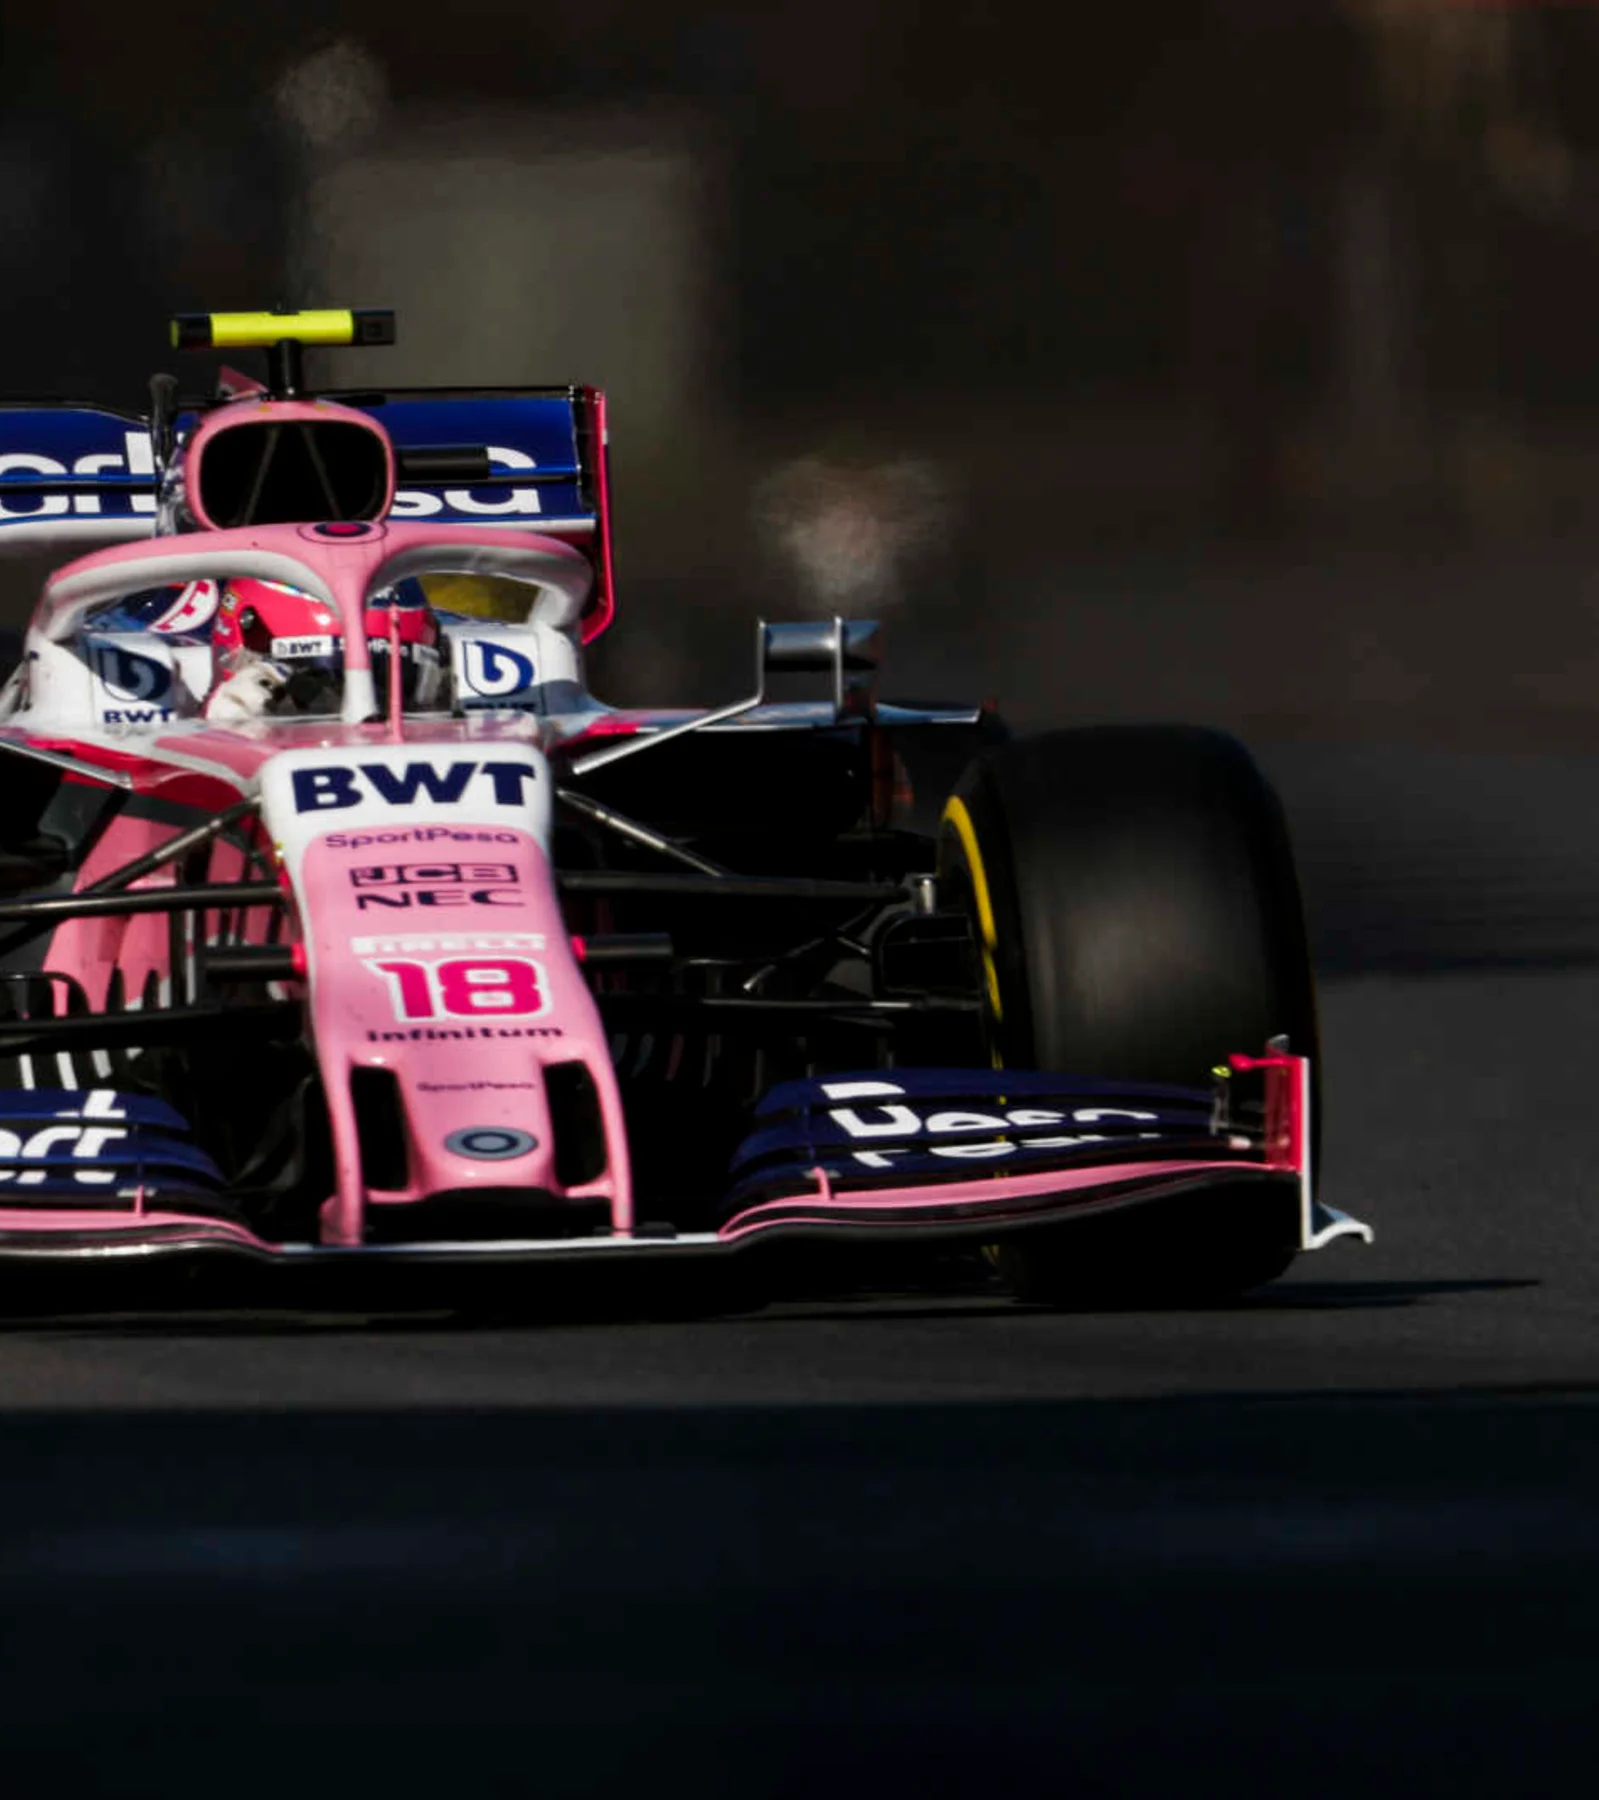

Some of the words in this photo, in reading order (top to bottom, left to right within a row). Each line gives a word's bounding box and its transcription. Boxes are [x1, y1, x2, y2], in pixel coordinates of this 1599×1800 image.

[104, 708, 174, 723] BWT
[292, 762, 535, 813] BWT
[326, 827, 519, 849] SportPesa
[350, 863, 519, 887] JCB
[357, 889, 526, 910] NEC
[365, 957, 550, 1021] 18
[367, 1027, 565, 1042] infinitum
